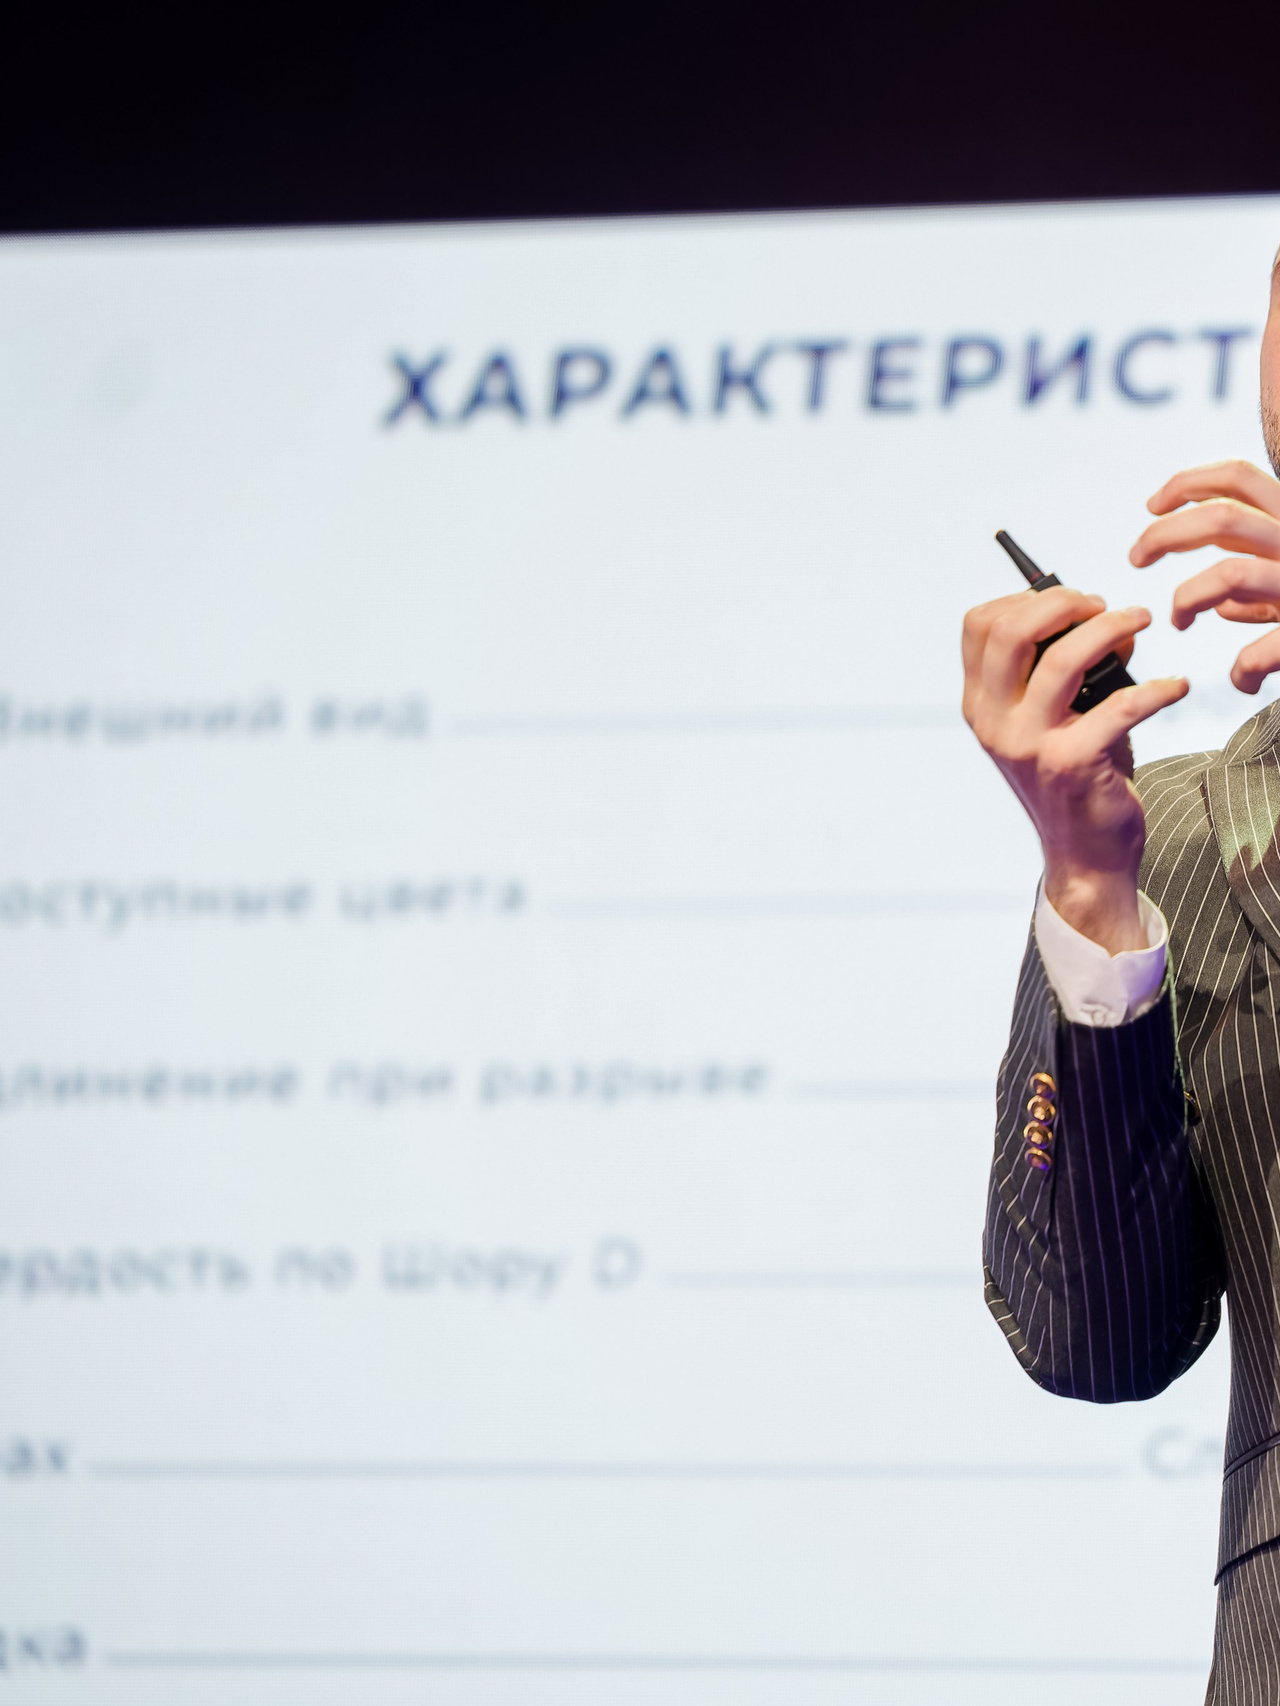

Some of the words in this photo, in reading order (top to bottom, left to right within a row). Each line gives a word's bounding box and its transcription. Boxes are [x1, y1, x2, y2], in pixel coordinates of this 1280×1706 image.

[306, 690, 430, 744] вид
[338, 870, 529, 926] цвета
[0, 1057, 298, 1110] линение
[273, 1244, 359, 1294] по
[380, 1238, 570, 1308] Шору
[592, 1234, 645, 1292] D
[0, 1622, 89, 1676] ка
